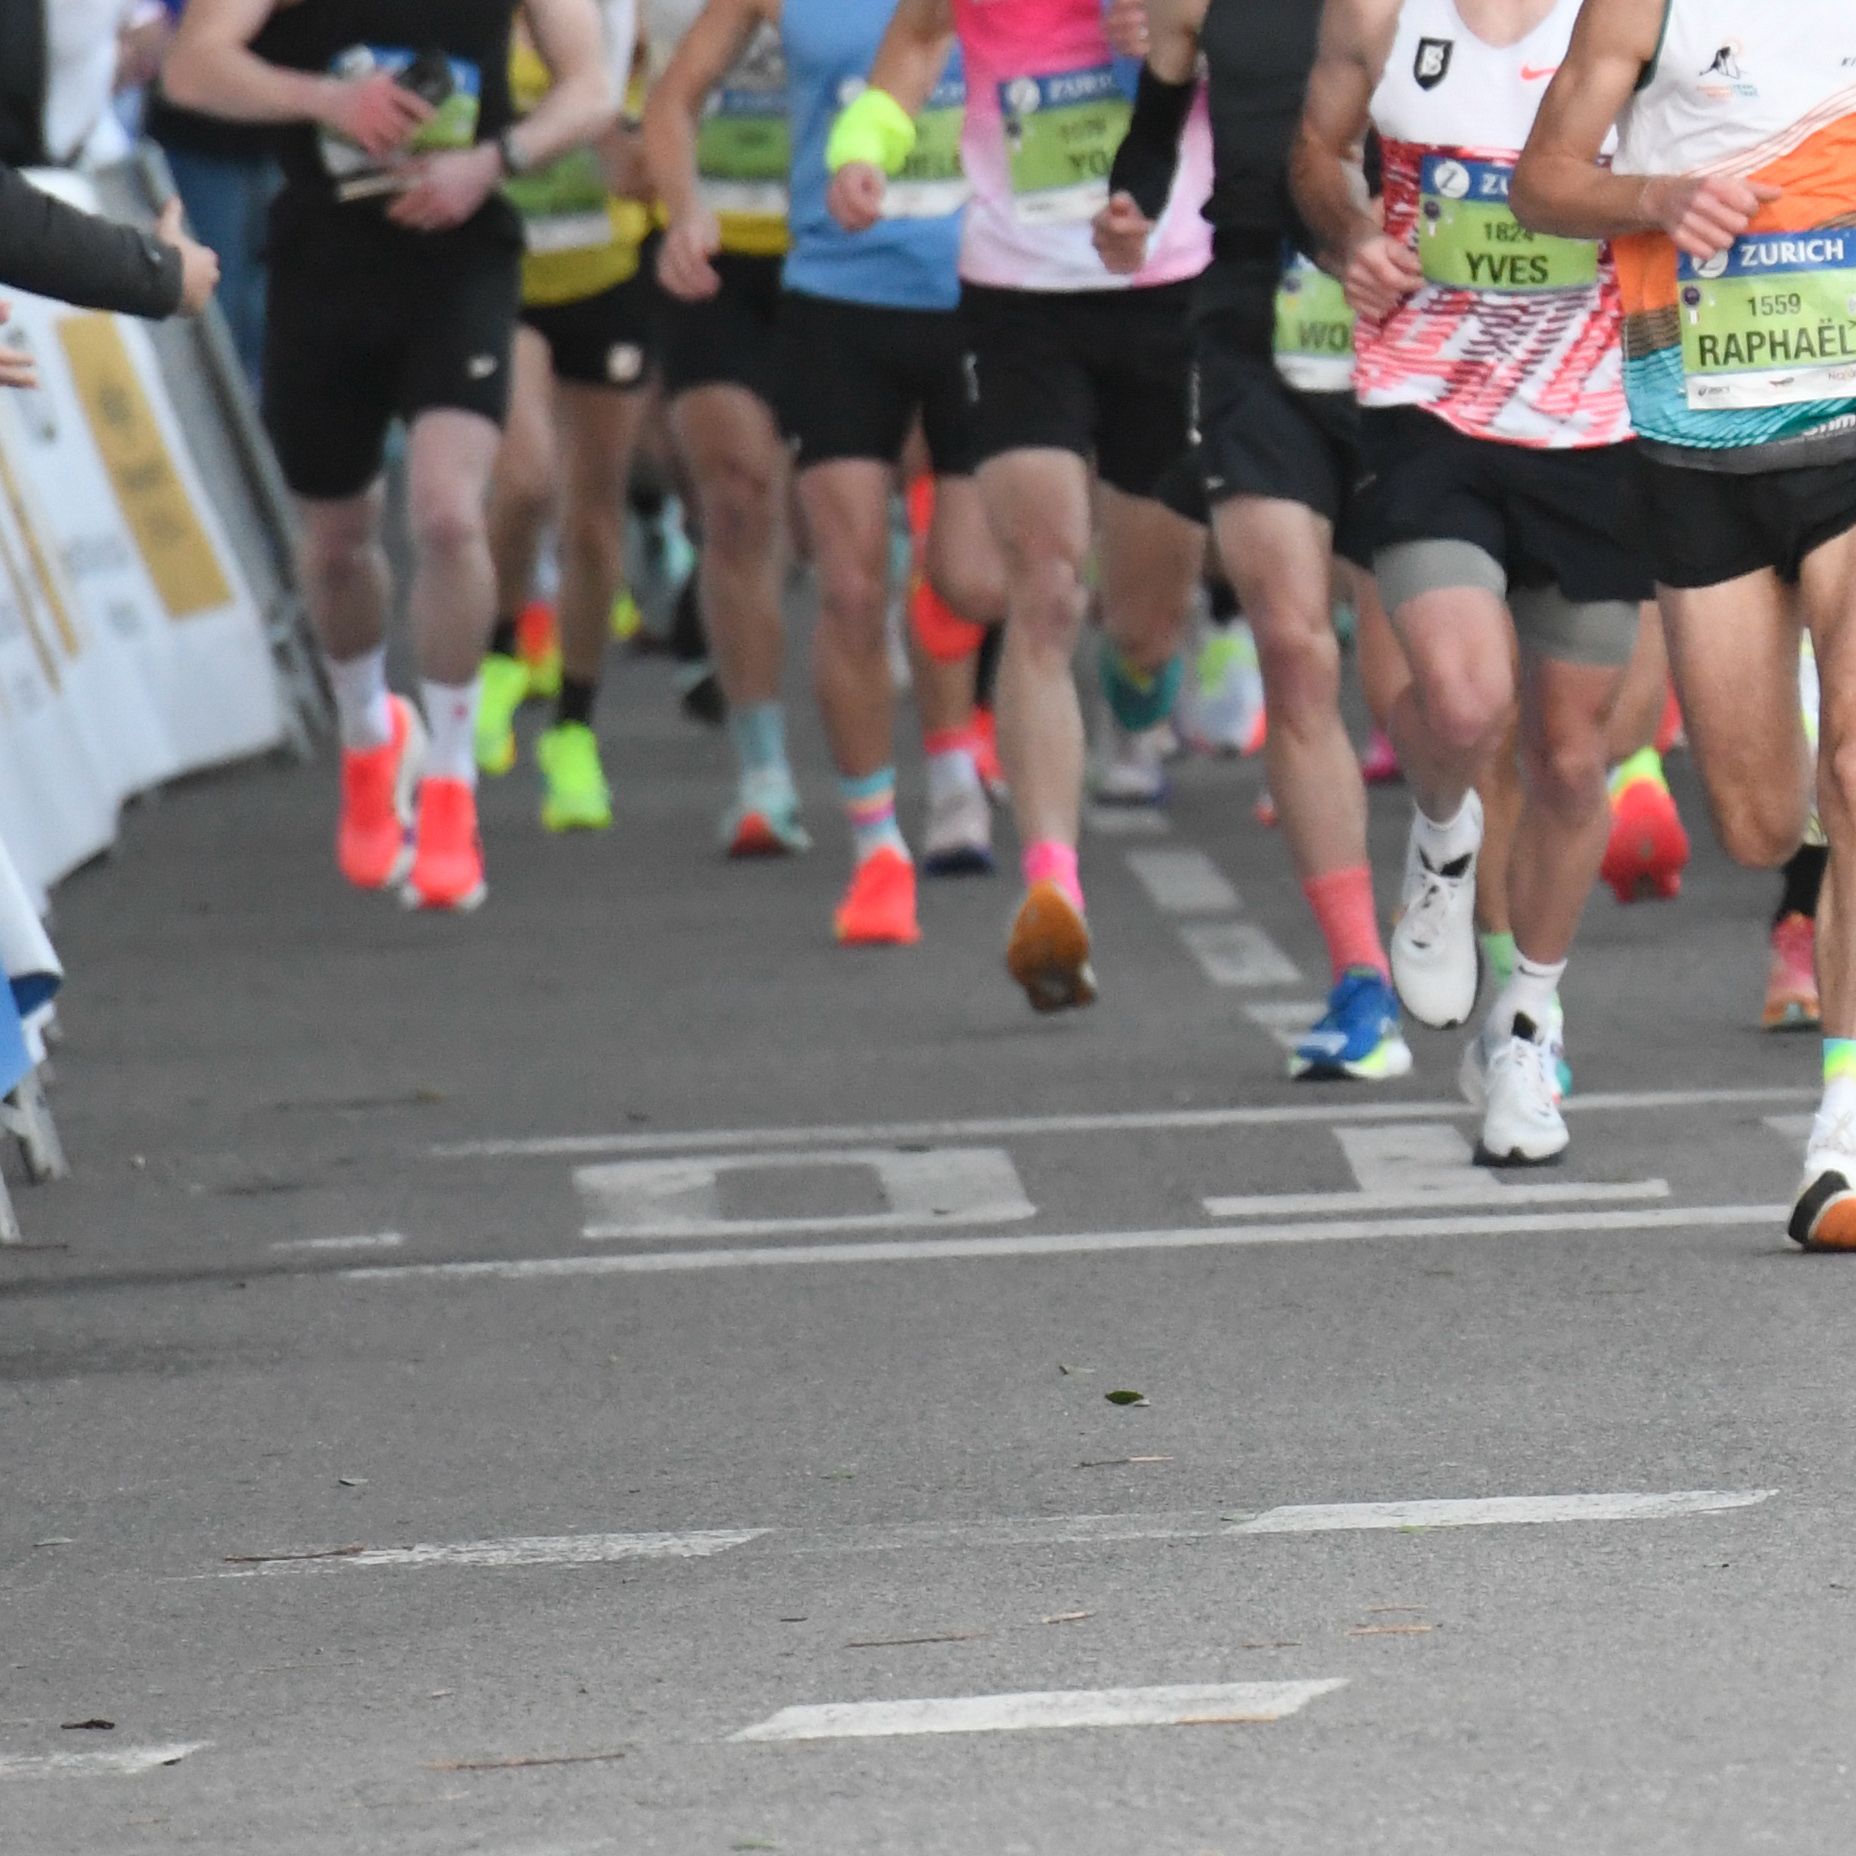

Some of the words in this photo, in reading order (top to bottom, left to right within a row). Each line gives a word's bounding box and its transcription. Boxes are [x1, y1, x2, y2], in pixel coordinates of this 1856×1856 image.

[1465, 251, 1550, 285] YVES
[1740, 237, 1846, 269] ZURICH
[1746, 291, 1802, 319] 1559
